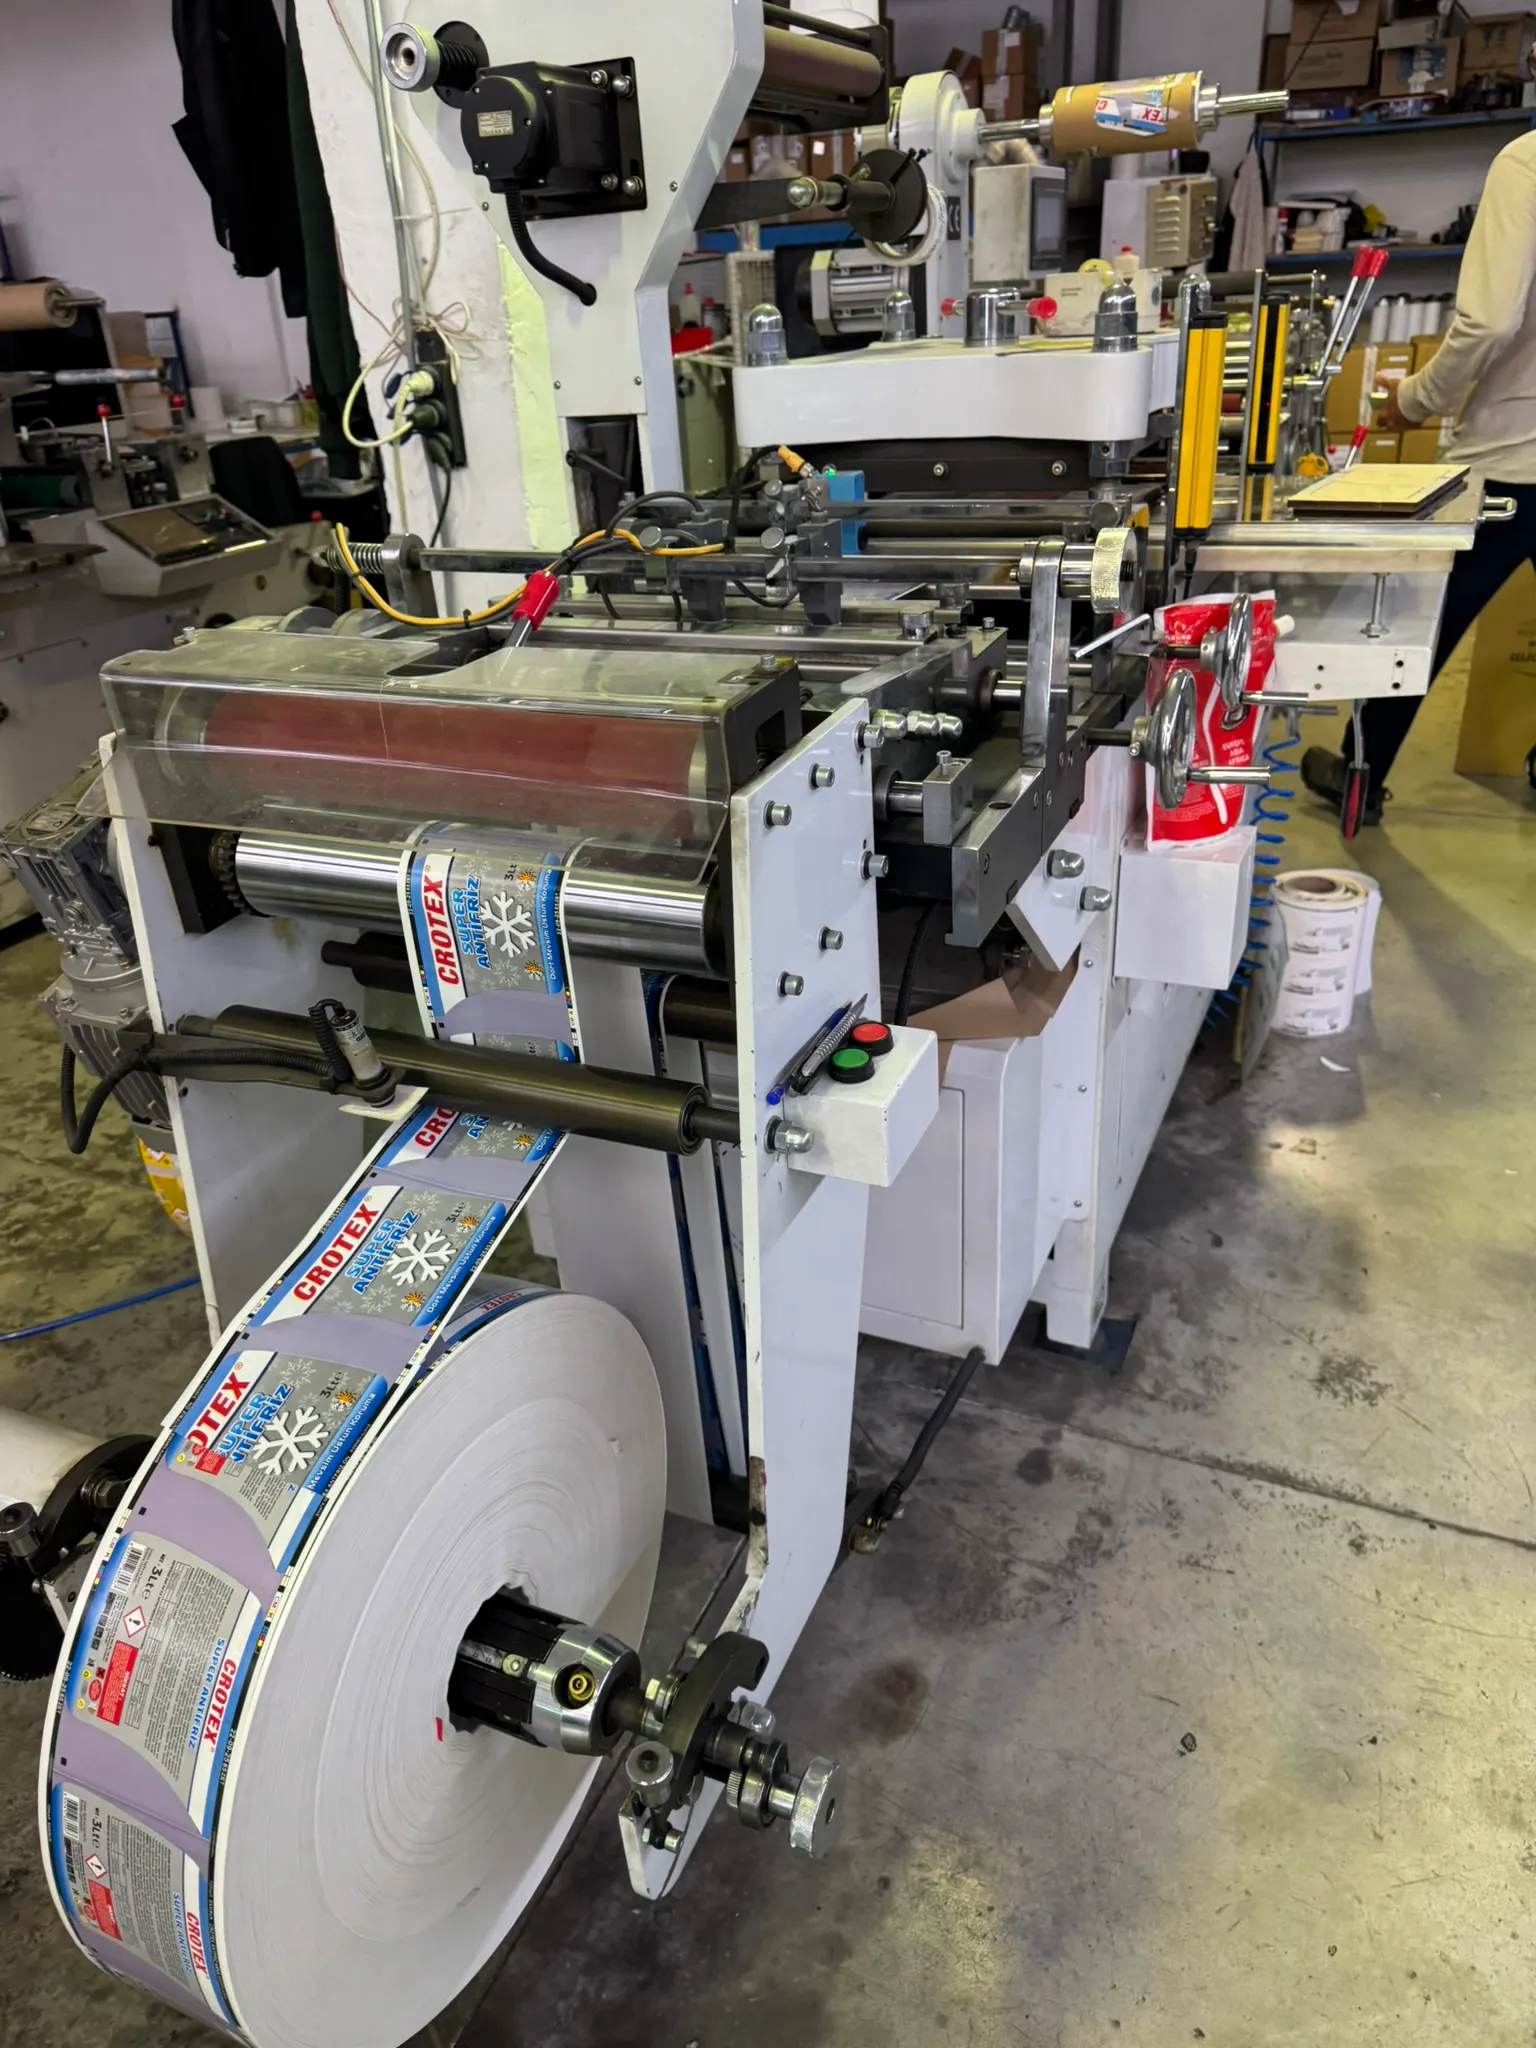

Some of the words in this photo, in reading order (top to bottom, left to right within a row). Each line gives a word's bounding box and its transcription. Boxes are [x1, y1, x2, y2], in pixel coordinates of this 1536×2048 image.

[1228, 754, 1250, 765] AFRICA
[540, 868, 552, 902] Koruma
[423, 874, 460, 986] CROTEX
[452, 887, 475, 956] SUPER
[465, 874, 492, 970] ANTİFRİZ
[292, 1202, 380, 1302] CROTEX
[345, 1218, 395, 1279] SUPER
[351, 1210, 421, 1296] ANTİFRİZ
[440, 1265, 463, 1296] Mevsim
[475, 1215, 496, 1244] Koruma
[307, 1452, 334, 1491] Mevsim
[349, 1392, 377, 1425] Koruma
[206, 1638, 225, 1684] SUPER
[187, 1686, 210, 1749] ANTİFRİZ
[203, 1658, 237, 1748] CROTEX
[223, 1728, 236, 1763] 22-09-25
[173, 1892, 182, 1929] SUPER
[187, 1912, 208, 1974] CROTEX
